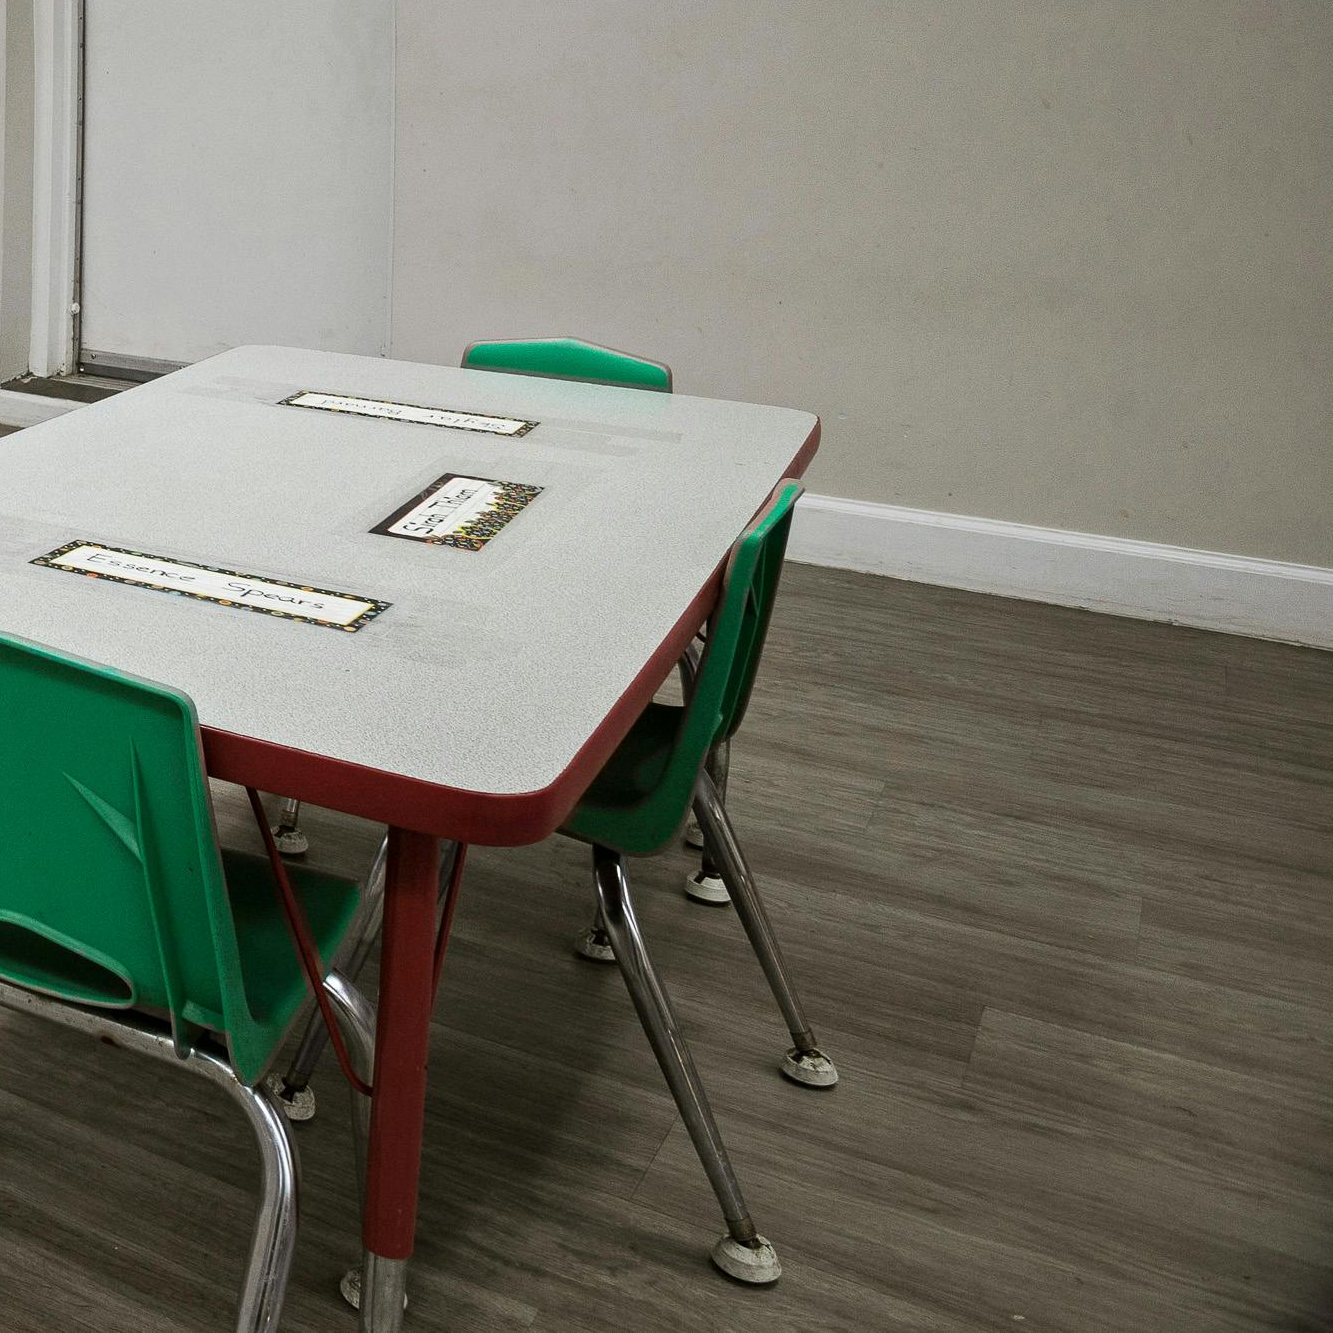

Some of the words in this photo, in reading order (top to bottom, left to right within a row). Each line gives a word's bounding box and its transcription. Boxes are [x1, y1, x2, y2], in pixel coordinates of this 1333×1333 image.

[402, 508, 448, 535] Sirah
[87, 553, 196, 582] Essence
[222, 581, 327, 610] Spears
